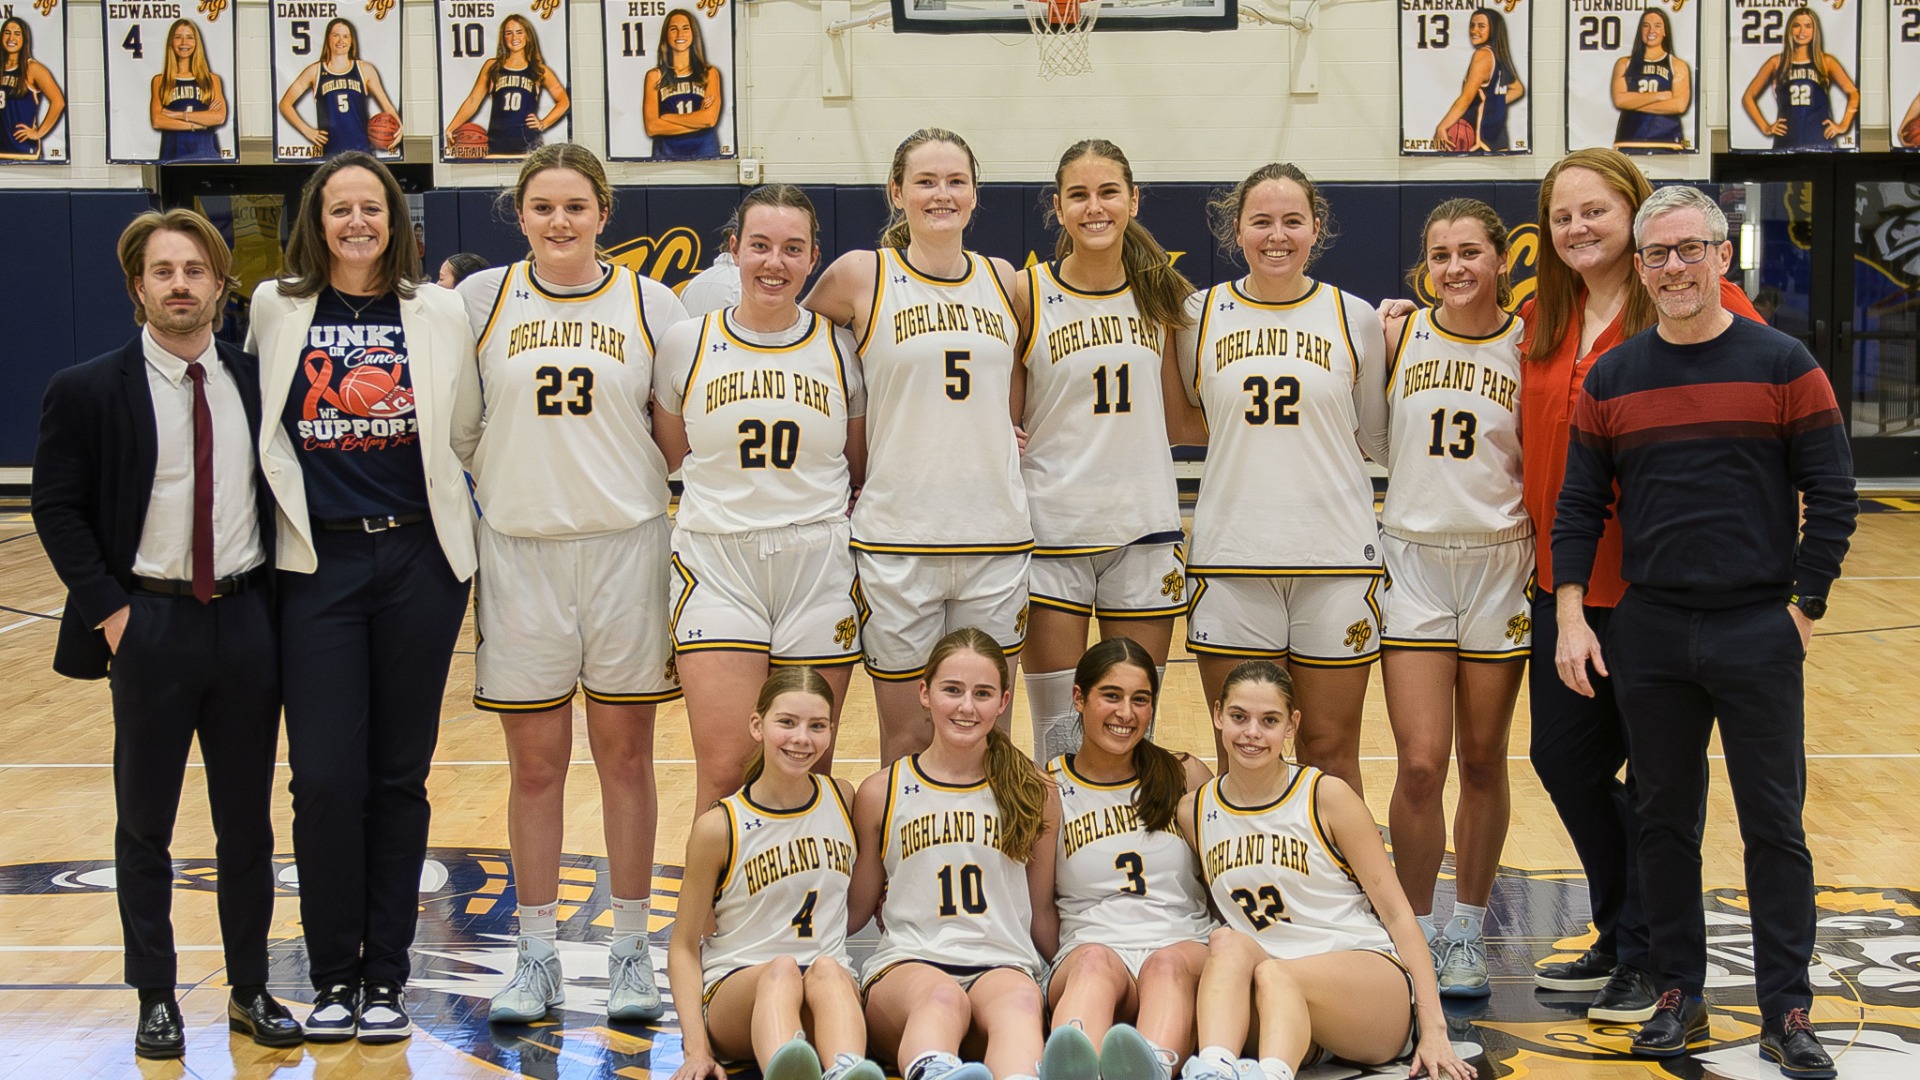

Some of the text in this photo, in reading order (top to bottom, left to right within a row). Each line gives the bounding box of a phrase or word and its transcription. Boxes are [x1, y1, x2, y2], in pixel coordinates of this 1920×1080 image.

[109, 4, 181, 18] EDWARDS
[277, 3, 338, 18] DANNER
[448, 3, 495, 18] JONES
[628, 2, 666, 16] HEIS
[122, 24, 143, 59] 4
[291, 21, 311, 55] 5
[452, 23, 485, 57] 10
[622, 22, 646, 57] 11
[1417, 14, 1450, 49] 13
[1579, 16, 1622, 50] 20
[1742, 10, 1783, 44] 22
[337, 94, 350, 113] 5
[503, 92, 522, 111] 10
[676, 100, 693, 115] 11
[1789, 84, 1811, 106] 22
[50, 149, 61, 157] JR.
[278, 146, 323, 157] CAPTAIN
[444, 146, 488, 157] CAPTAIN
[1404, 139, 1447, 151] CAPTAIN
[1515, 141, 1526, 149] SR.
[508, 319, 627, 364] HIGHLAND PARK
[894, 302, 1010, 346] HIGHLAND PARK
[1048, 315, 1123, 366] HIGHLAND
[329, 347, 345, 356] ON
[1215, 327, 1332, 374] HIGHLAND PARK
[535, 365, 595, 417] 23
[706, 369, 831, 418] HIGHLAND PARK
[944, 350, 972, 402] 5
[1092, 362, 1132, 415] 11
[1403, 359, 1517, 414] HIGHLAND PARK
[319, 408, 339, 419] WE
[1242, 374, 1301, 427] 32
[737, 418, 801, 471] 20
[1428, 407, 1478, 461] 13
[900, 810, 1000, 861] HIGHLAND PA
[1063, 804, 1140, 860] HIGHLAND
[744, 836, 852, 897] HIGHLAND PARK
[1271, 834, 1310, 877] PARK
[937, 863, 988, 917] 10
[1115, 851, 1147, 897] 3
[791, 889, 819, 938] 4
[1230, 884, 1293, 932] 22
